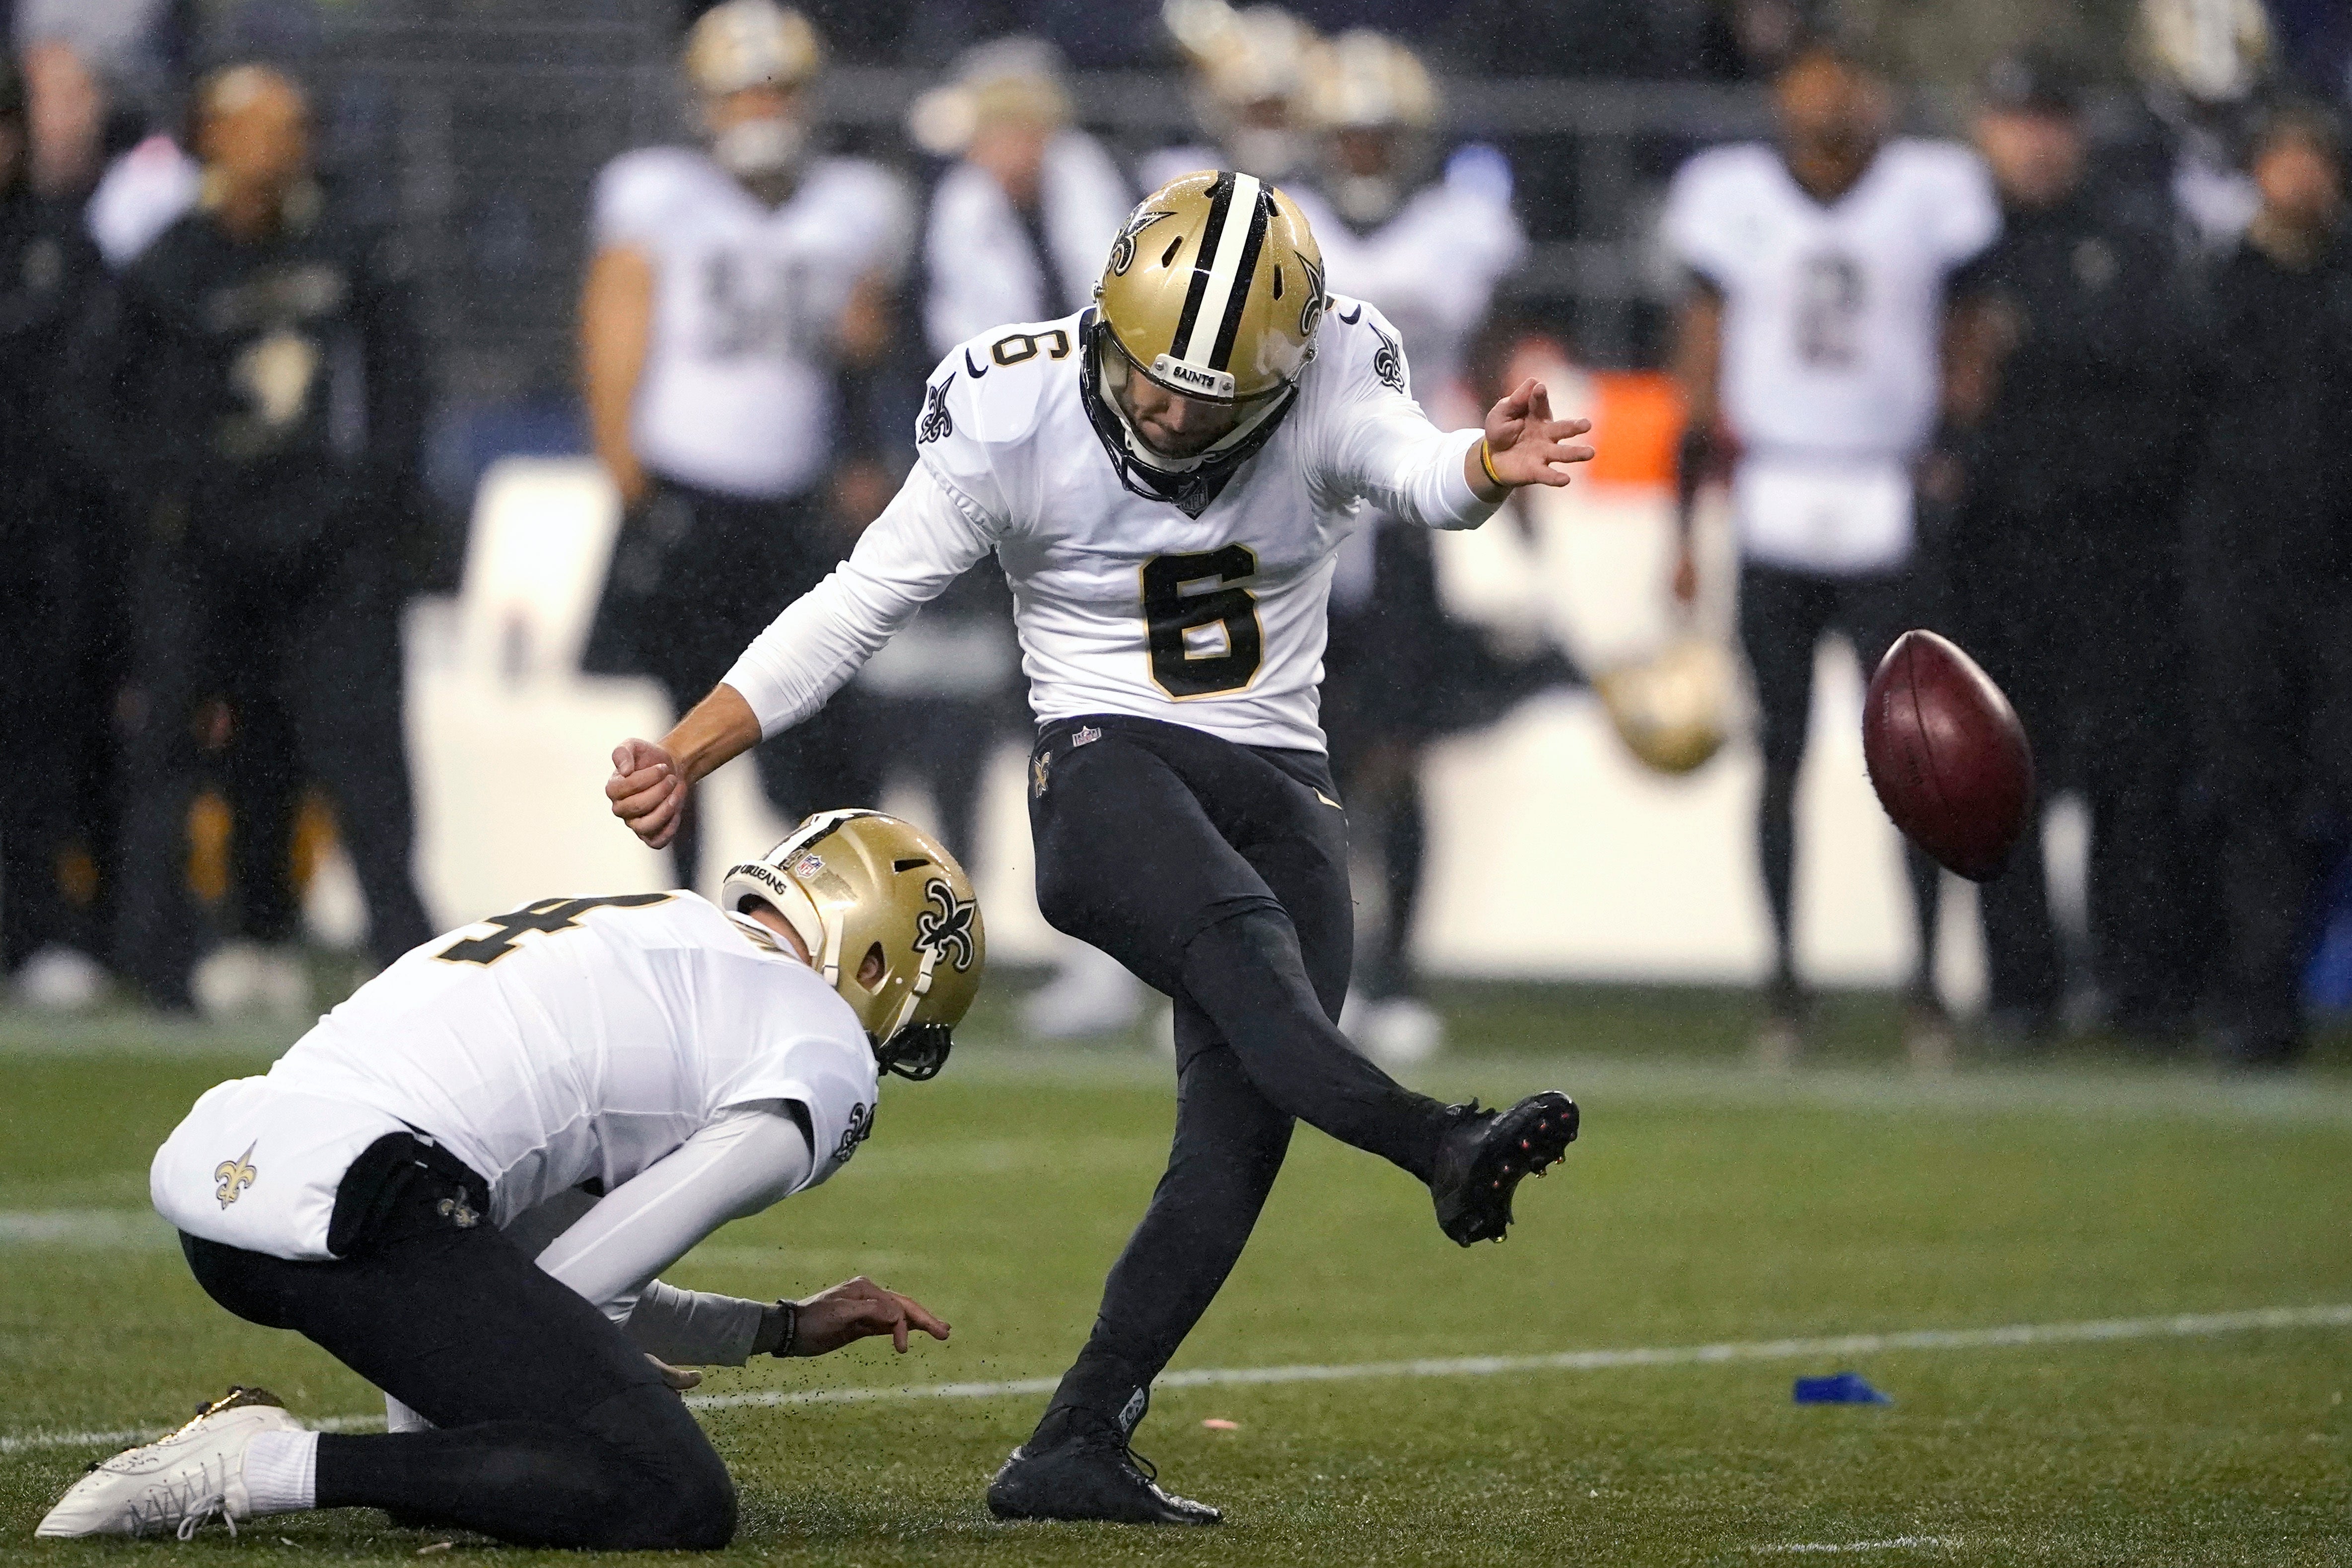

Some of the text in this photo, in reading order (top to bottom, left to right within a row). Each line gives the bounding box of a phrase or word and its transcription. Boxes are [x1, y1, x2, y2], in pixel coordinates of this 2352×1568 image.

[990, 330, 1072, 368] 6
[1173, 366, 1216, 387] SAINTS
[1139, 542, 1264, 703] 6
[798, 859, 815, 876] NFL
[430, 893, 680, 969] 4
